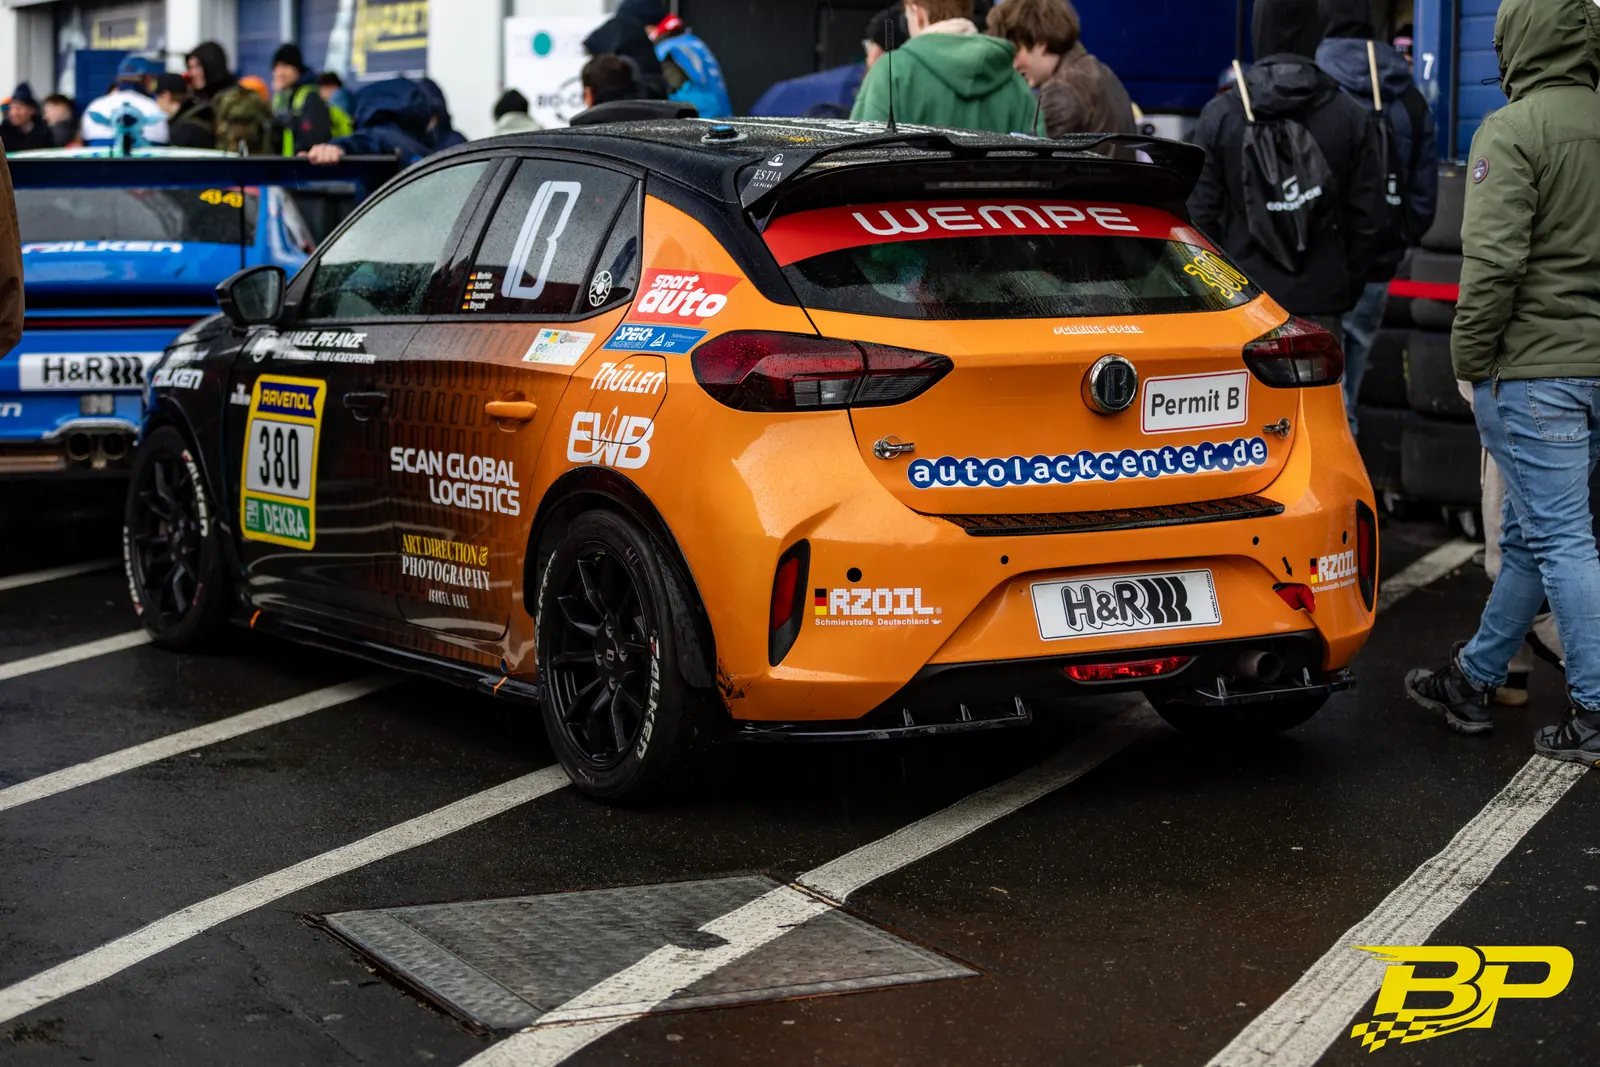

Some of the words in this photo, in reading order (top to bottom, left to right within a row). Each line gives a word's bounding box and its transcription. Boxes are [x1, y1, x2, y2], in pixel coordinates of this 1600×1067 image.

[1422, 53, 1434, 80] 7
[753, 169, 782, 182] ESTIA
[200, 189, 243, 208] 44
[852, 205, 1140, 235] WEMPE
[22, 240, 183, 254] FALKEN
[651, 274, 699, 291] sport
[1183, 249, 1248, 299] 380
[637, 288, 728, 317] auto
[315, 332, 367, 348] PFLANZE
[43, 357, 102, 384] H&R
[262, 389, 312, 410] RAVENOL
[1150, 389, 1221, 418] Permit
[1226, 387, 1240, 410] B
[567, 405, 655, 469] EWB
[259, 425, 299, 490] 380
[390, 446, 442, 476] SCAN
[446, 453, 519, 487] GLOBAL
[913, 441, 1264, 482] autolackcenter.de
[429, 478, 520, 516] LOGISTICS
[262, 503, 308, 540] DEKRA
[402, 533, 422, 554] ART
[423, 537, 478, 565] DIRECTION
[479, 546, 488, 567] &
[1318, 549, 1357, 583] RZOIL
[402, 555, 490, 591] PHOTOGRAPHY
[815, 618, 873, 626] Schmierstoffe
[877, 617, 929, 626] Deutschland
[1061, 582, 1149, 631] H&R
[637, 635, 660, 760] FALKEN
